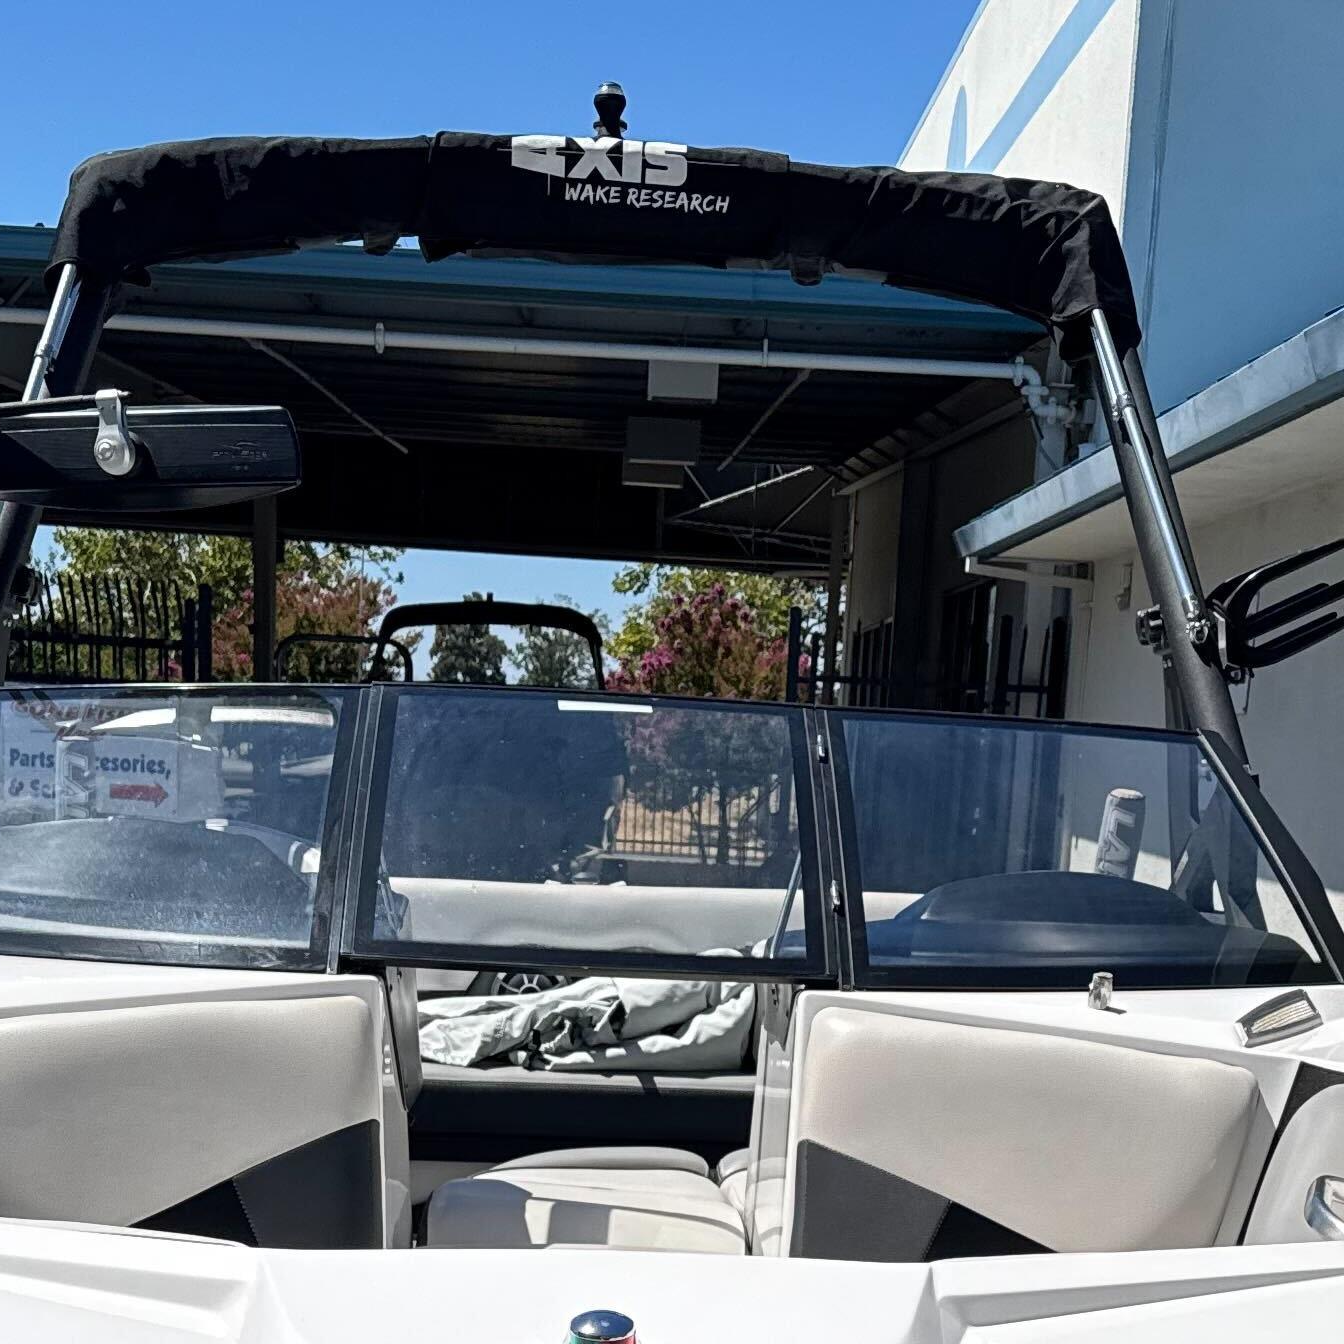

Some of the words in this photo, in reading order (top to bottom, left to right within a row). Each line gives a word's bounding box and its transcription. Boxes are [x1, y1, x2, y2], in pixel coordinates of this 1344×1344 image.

[511, 135, 688, 187] AXIS
[564, 182, 622, 205] WAKE
[626, 188, 730, 215] RESEARCH
[10, 748, 55, 769] Parts
